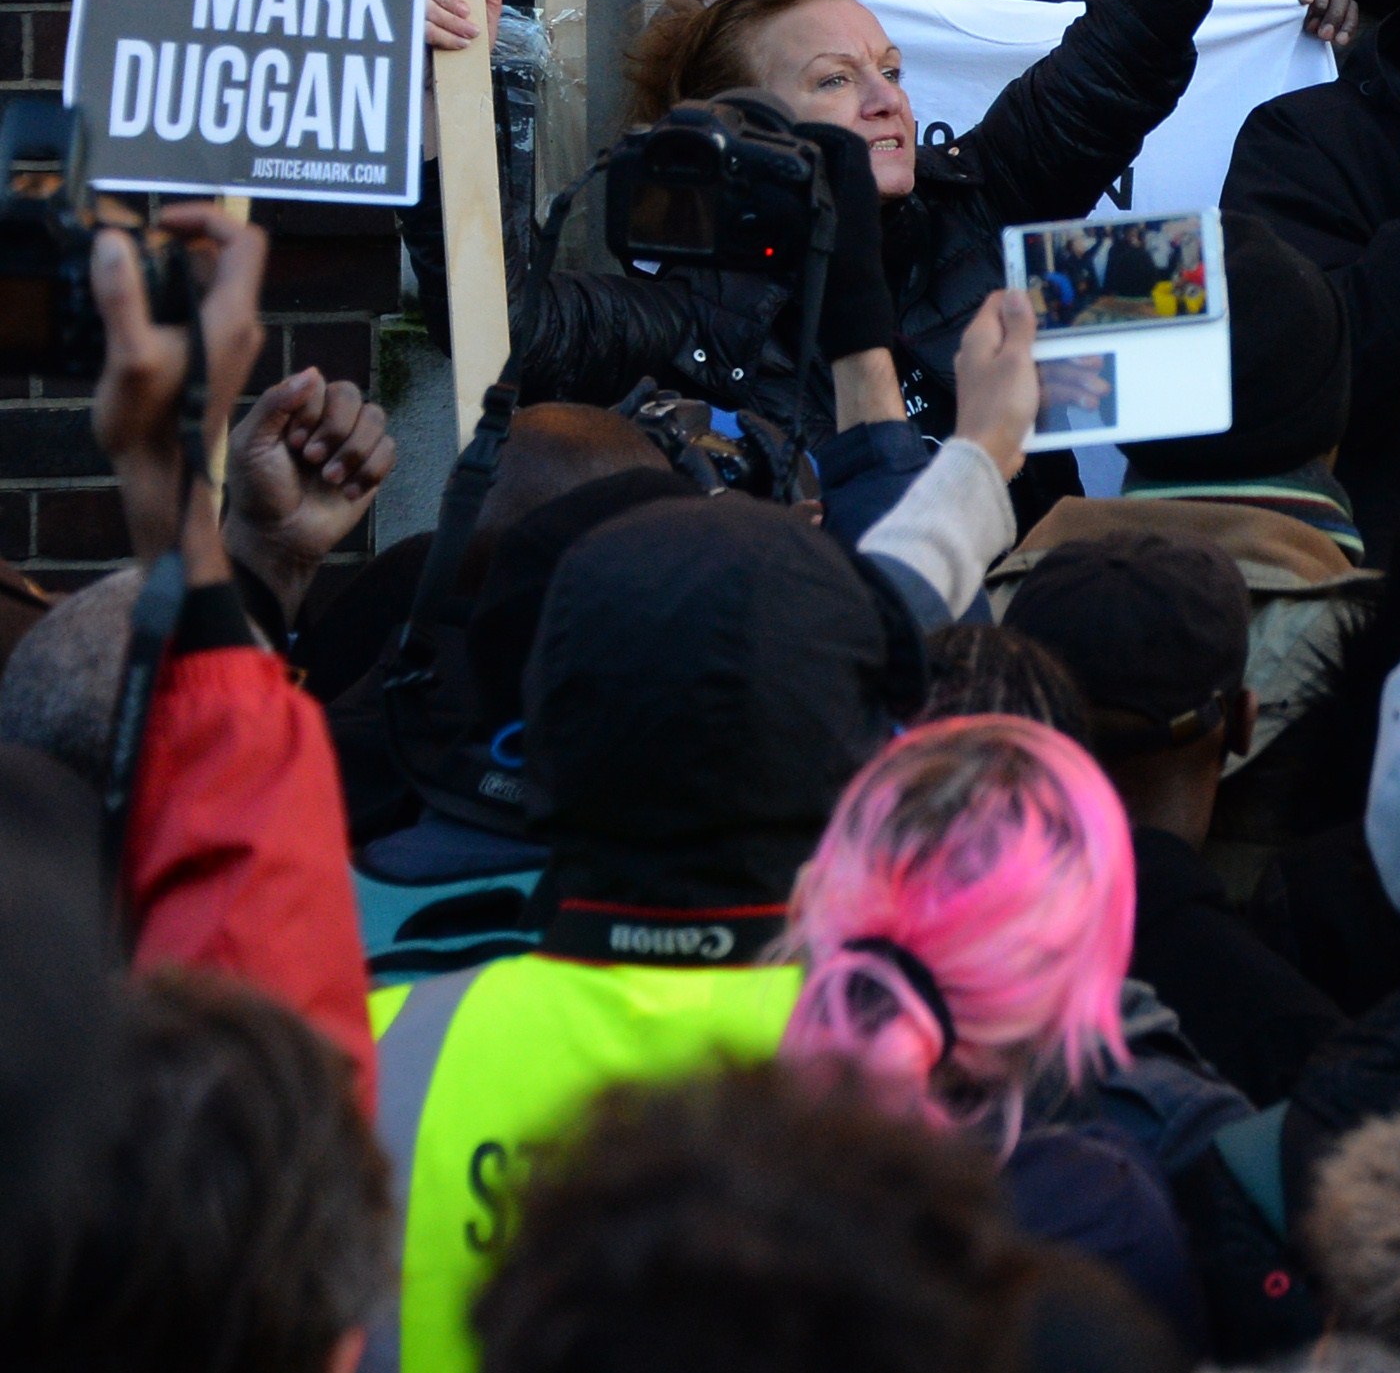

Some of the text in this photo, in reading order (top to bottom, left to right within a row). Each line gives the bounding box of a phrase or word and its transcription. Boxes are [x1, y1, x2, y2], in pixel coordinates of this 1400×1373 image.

[109, 37, 390, 153] DUGGAN
[252, 157, 387, 185] JUSTICE4MARK.COM
[609, 924, 734, 959] Canon
